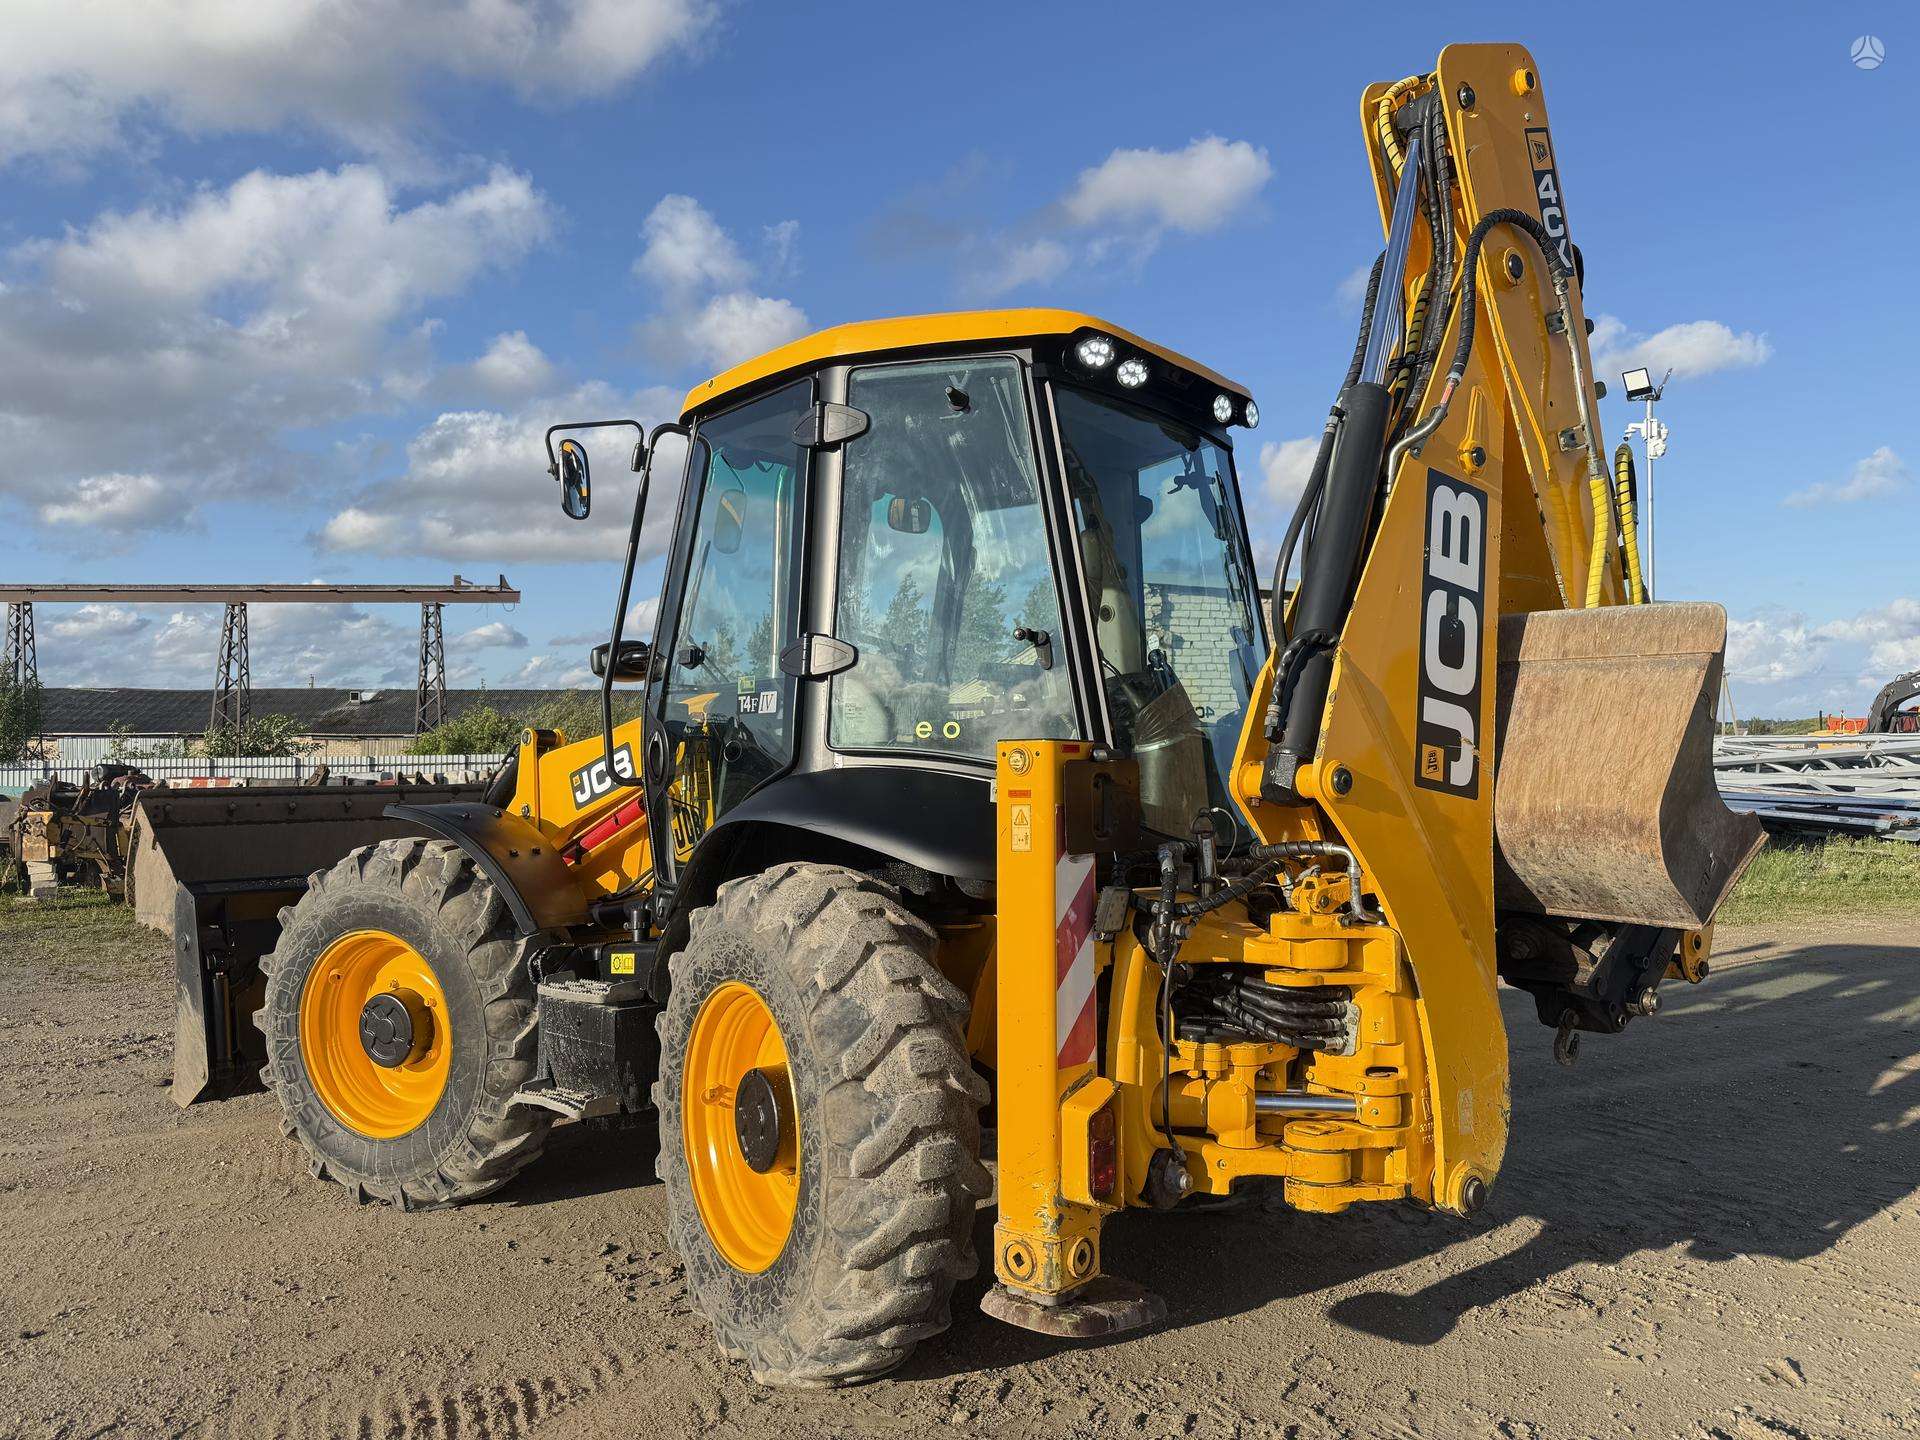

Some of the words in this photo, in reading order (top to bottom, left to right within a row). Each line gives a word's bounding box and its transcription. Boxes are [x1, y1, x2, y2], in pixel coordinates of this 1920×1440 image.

[1423, 484, 1482, 787] JCB
[738, 695, 758, 713] T4F
[760, 693, 774, 712] IV
[575, 749, 633, 804] JCB
